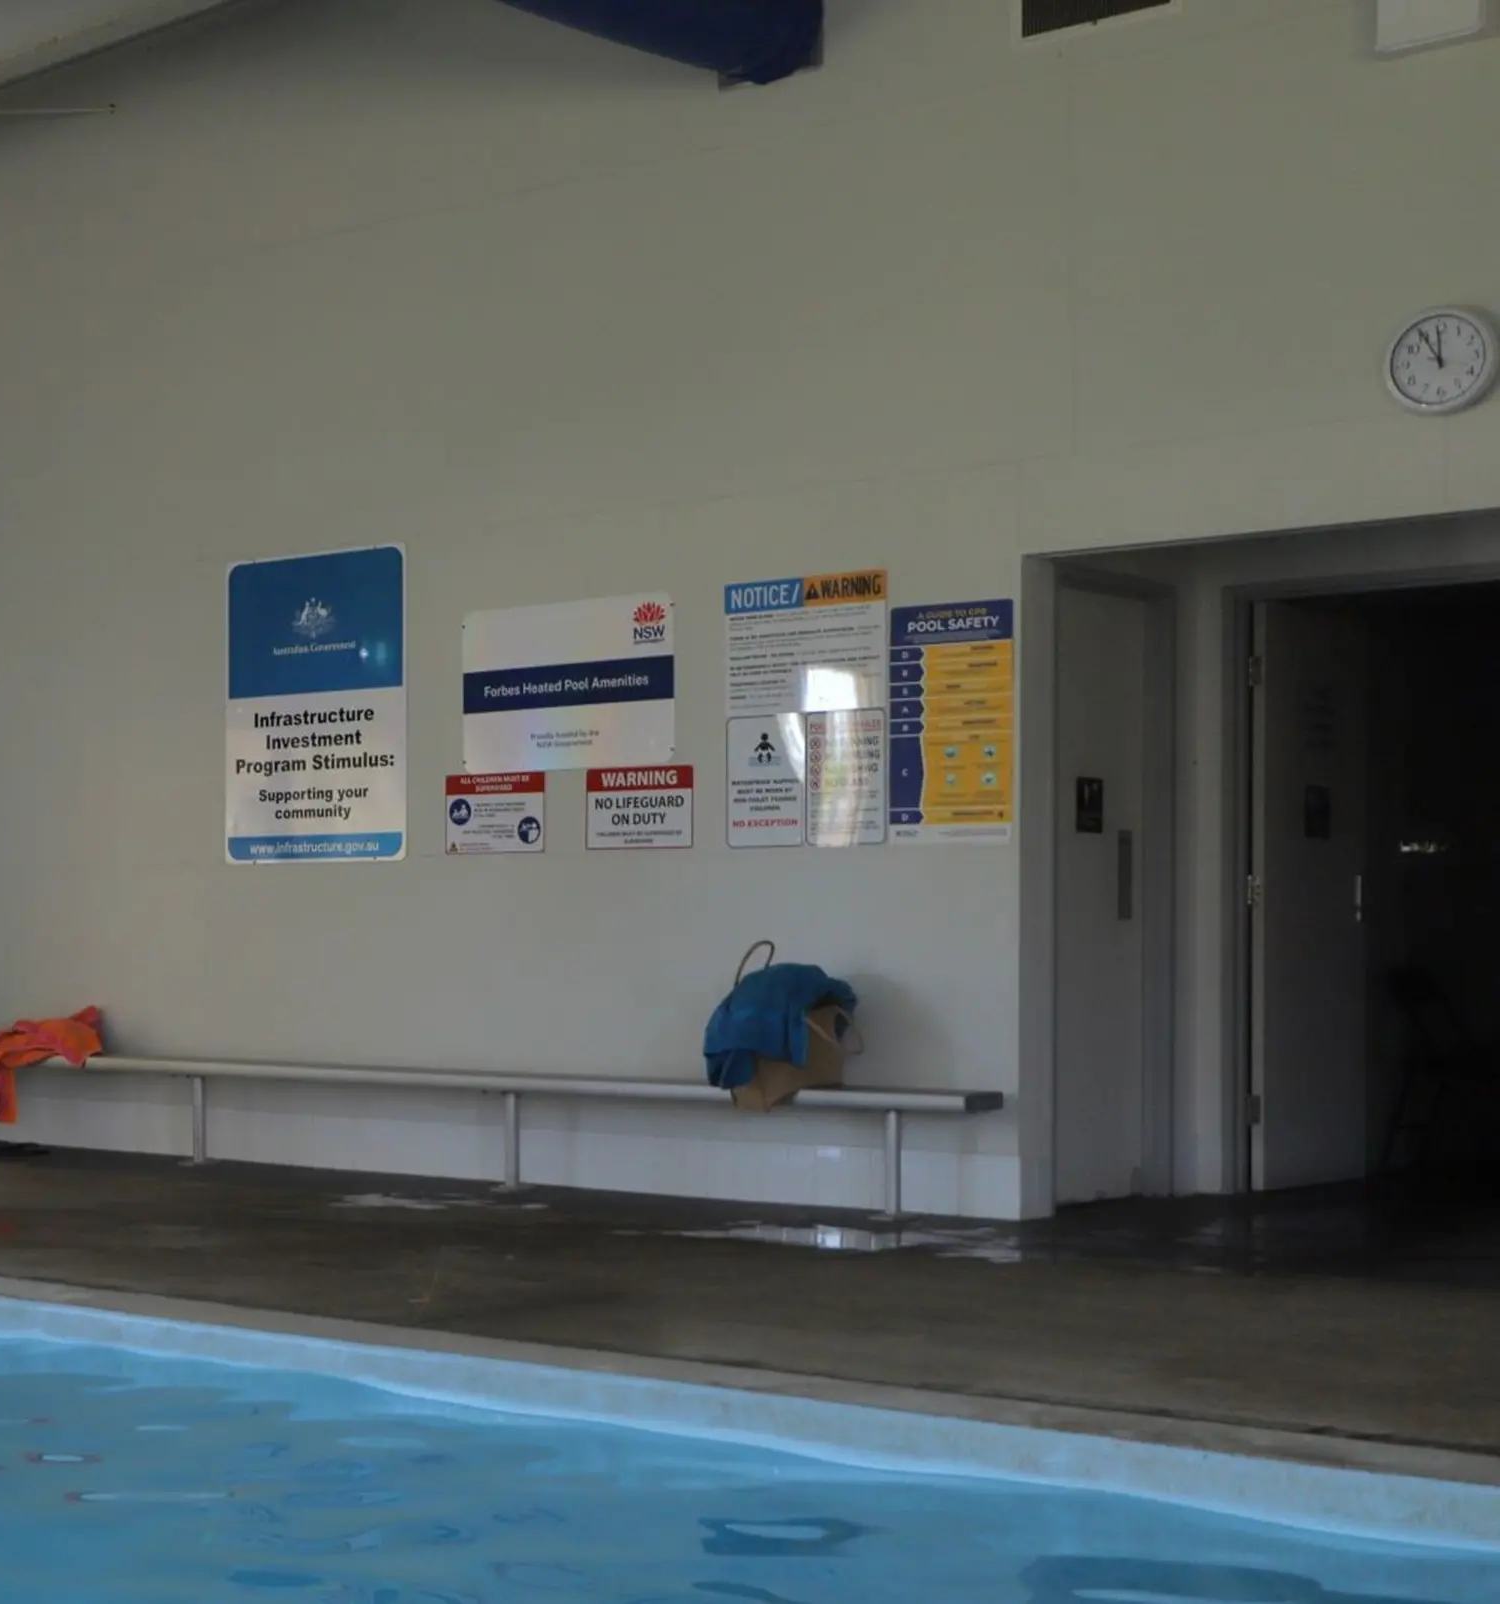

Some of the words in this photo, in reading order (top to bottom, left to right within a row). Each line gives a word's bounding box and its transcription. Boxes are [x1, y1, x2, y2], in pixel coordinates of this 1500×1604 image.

[1407, 343, 1421, 356] 10
[730, 583, 800, 609] NOTICE/
[820, 574, 883, 599] WARNING
[907, 620, 945, 633] POOL
[948, 615, 1000, 630] SAFETY
[633, 625, 665, 641] NSW
[273, 644, 310, 656] Australian
[311, 641, 357, 653] Government
[484, 684, 521, 699] Forbes
[523, 680, 562, 695] Heated
[564, 677, 589, 692] Pool
[592, 673, 649, 689] Amenities
[254, 707, 375, 728] Infrastructure
[266, 729, 362, 750] Investment
[236, 758, 306, 777] Program
[312, 752, 395, 770] Stimulus:
[601, 769, 678, 788] WARNING
[259, 786, 333, 804] Supporting
[338, 787, 369, 801] your
[595, 797, 613, 810] NO
[616, 795, 685, 809] LIFEGUARD
[275, 805, 352, 820] community
[611, 813, 630, 825] ON
[632, 812, 667, 825] DUTY
[732, 819, 746, 829] NO
[747, 817, 799, 828] EXCEPTION
[250, 840, 380, 856] www.infrastructure.gov.au
